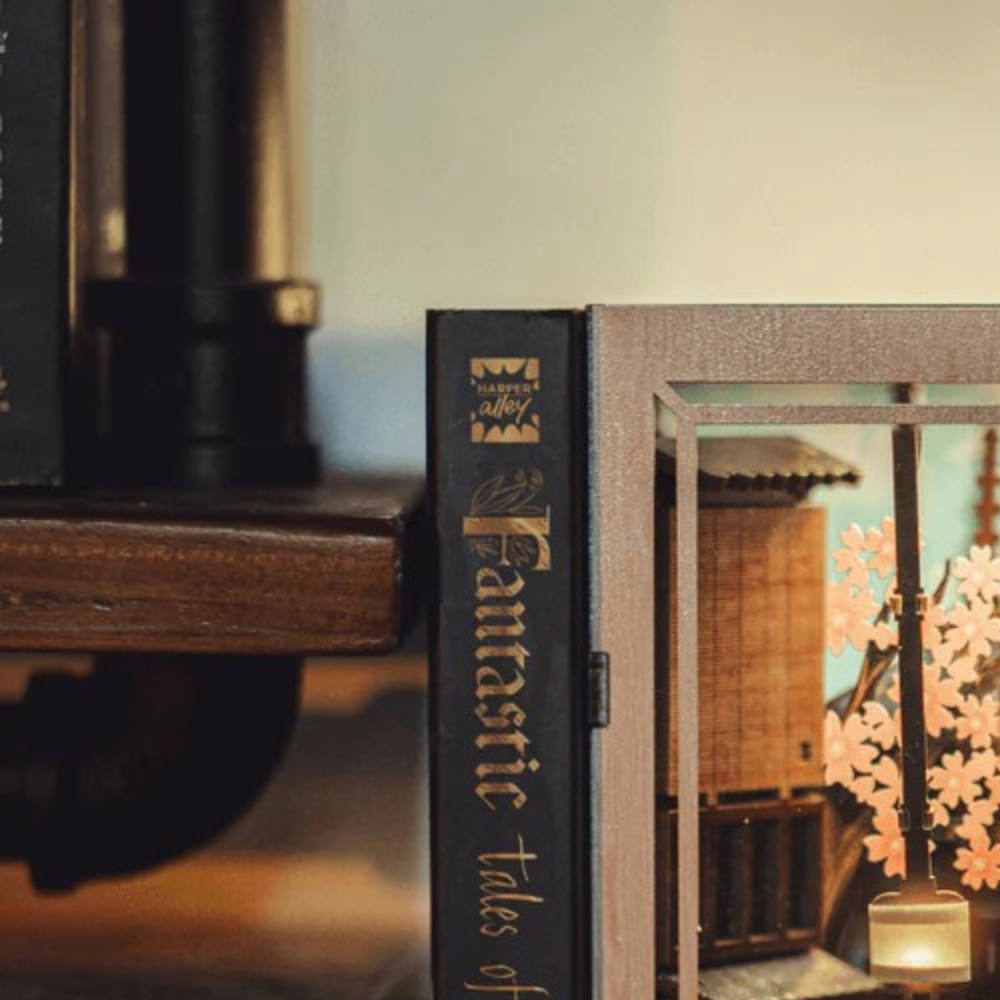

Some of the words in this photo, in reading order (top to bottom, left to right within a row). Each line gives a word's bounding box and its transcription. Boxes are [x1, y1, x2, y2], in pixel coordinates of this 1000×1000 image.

[477, 383, 531, 394] HARPER
[479, 394, 532, 424] alley
[463, 505, 551, 811] Fantastic
[479, 834, 543, 937] tales
